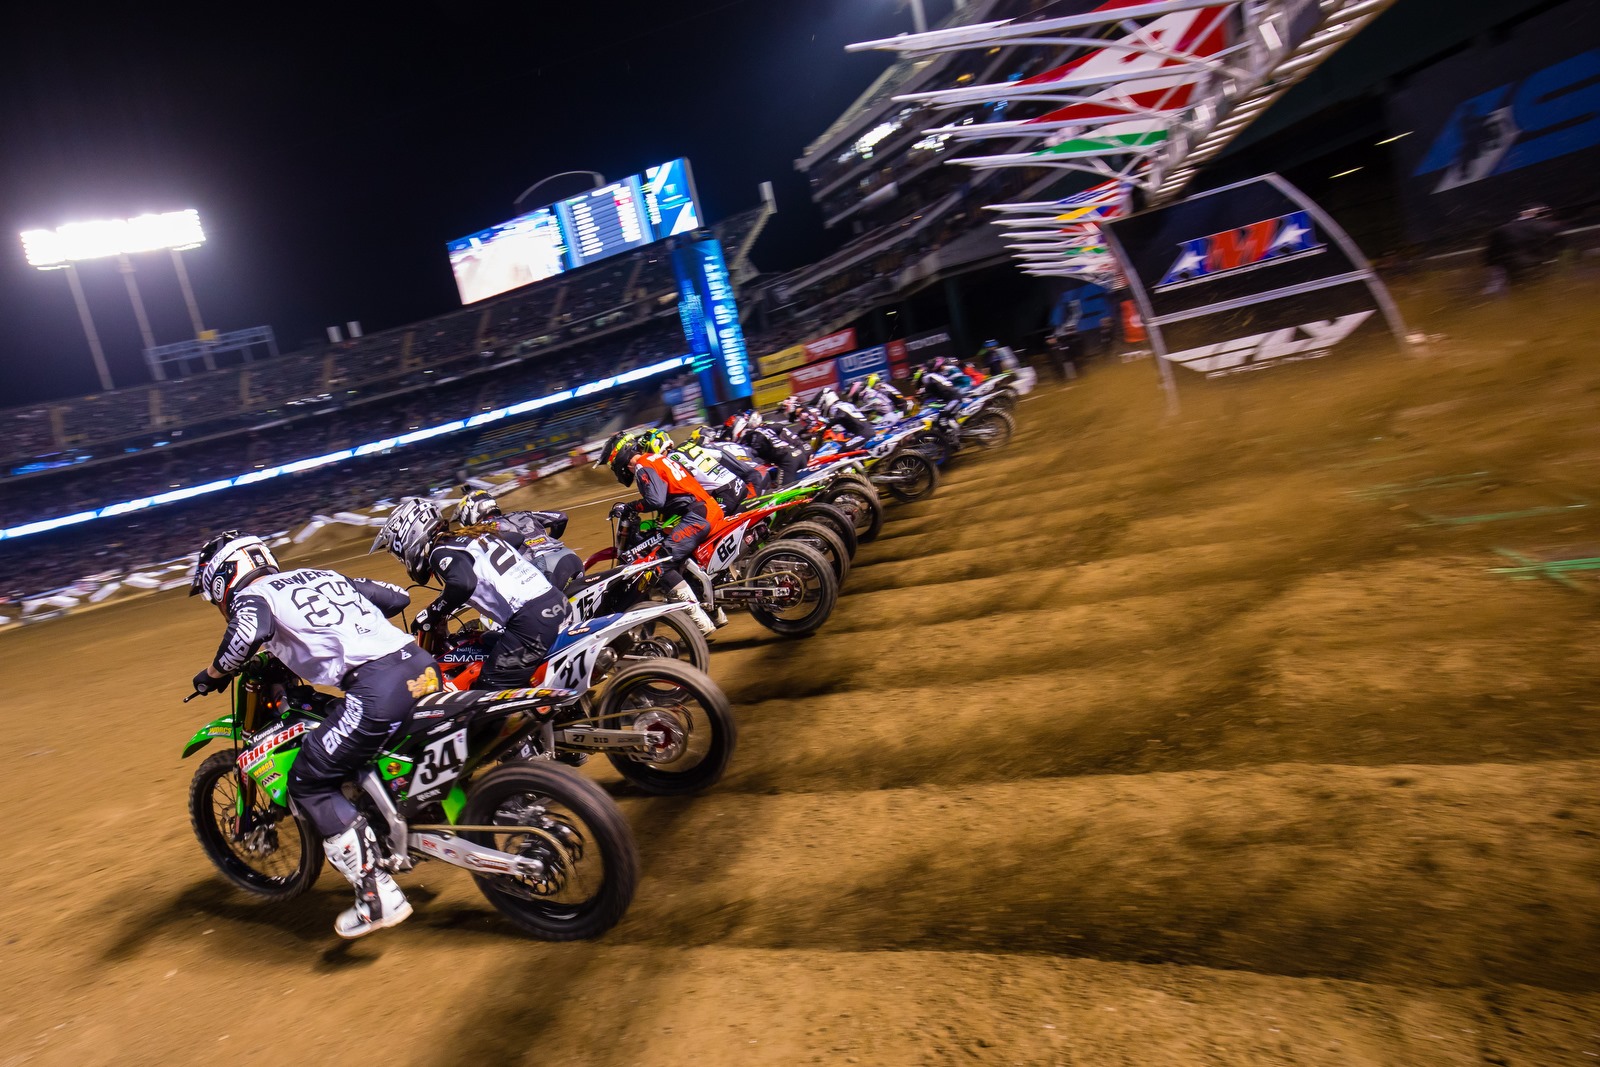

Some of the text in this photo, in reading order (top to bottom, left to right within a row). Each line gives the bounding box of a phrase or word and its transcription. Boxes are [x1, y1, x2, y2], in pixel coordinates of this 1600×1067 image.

[630, 533, 663, 556] THROTTLE
[717, 534, 738, 562] 82
[291, 581, 371, 627] 34
[554, 649, 588, 689] 27
[253, 721, 284, 743] Kawasaki
[572, 734, 585, 743] 27
[593, 736, 608, 744] DID
[419, 738, 463, 785] 34
